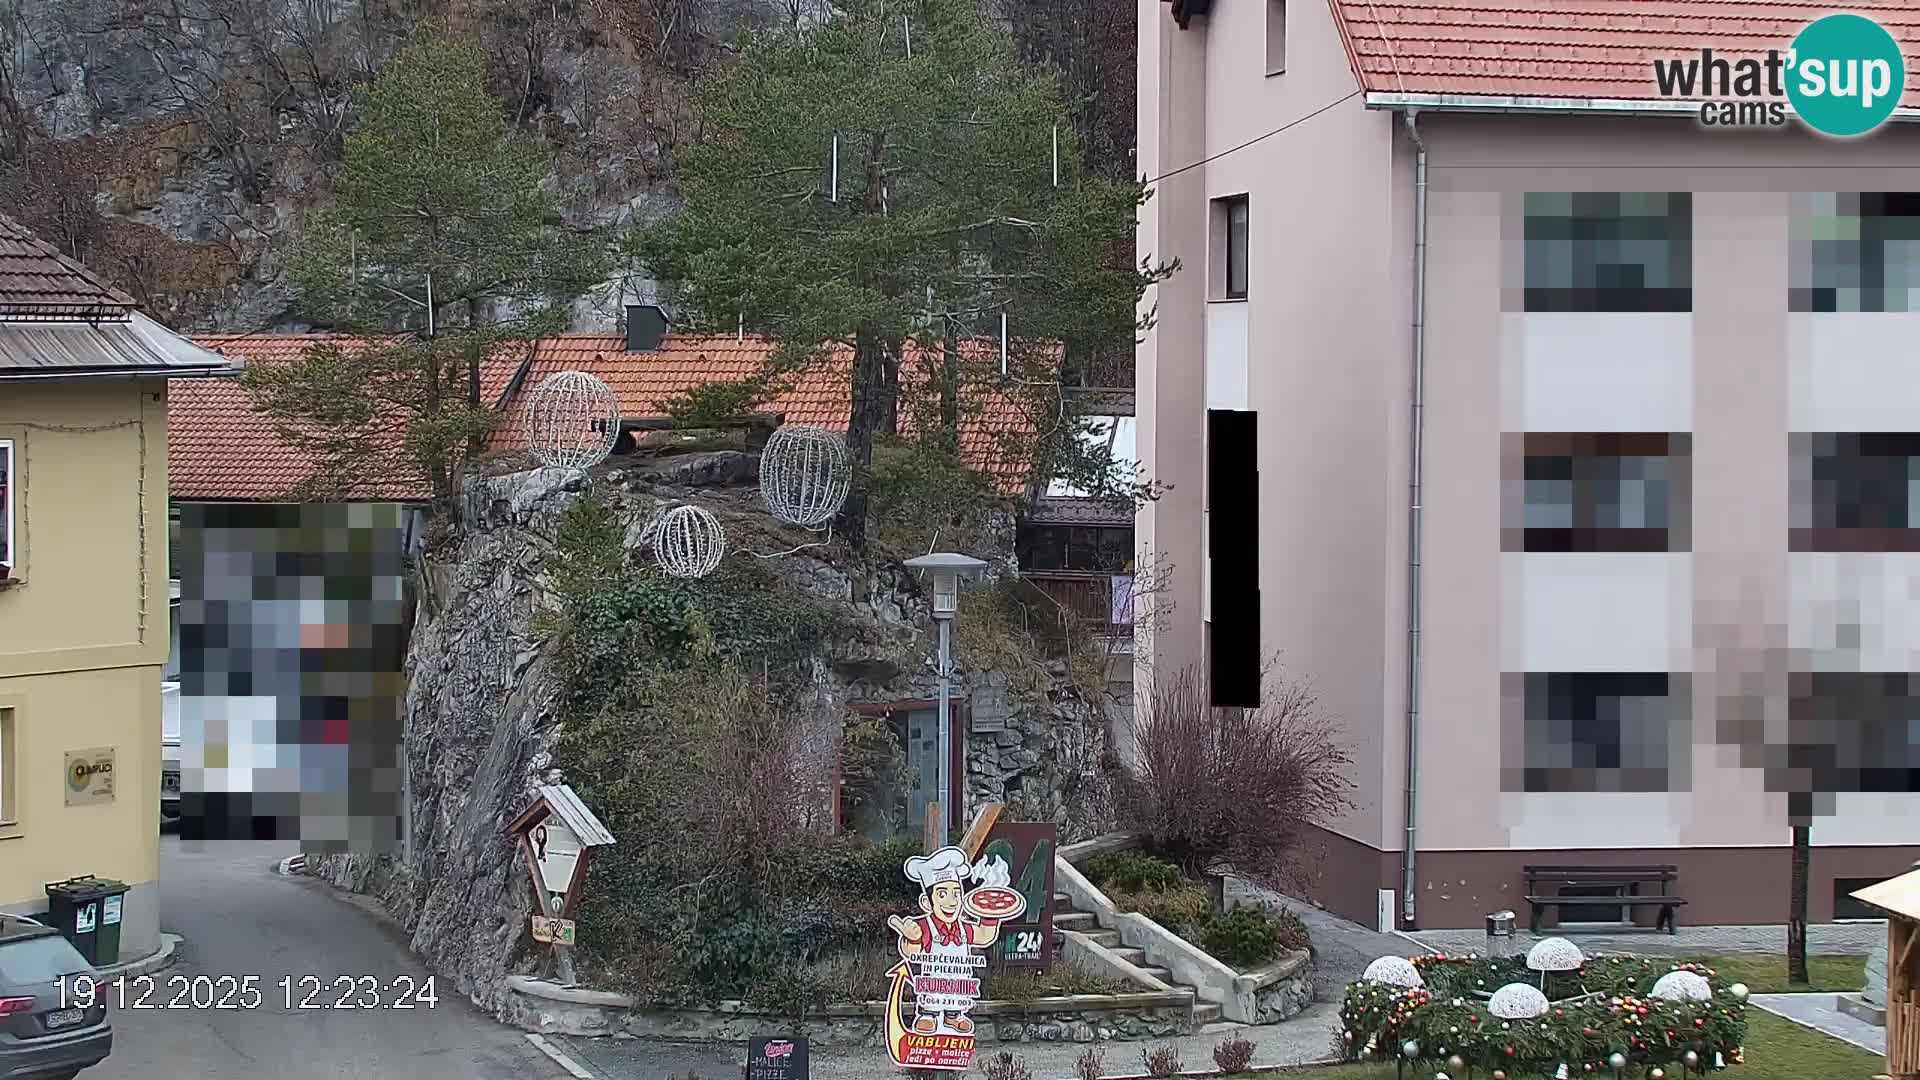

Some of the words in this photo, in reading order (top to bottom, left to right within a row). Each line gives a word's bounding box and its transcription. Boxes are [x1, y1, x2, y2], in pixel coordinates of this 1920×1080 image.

[934, 964, 972, 976] PICERIJA
[917, 977, 978, 995] KURNIK
[908, 1035, 975, 1050] VABLJENI
